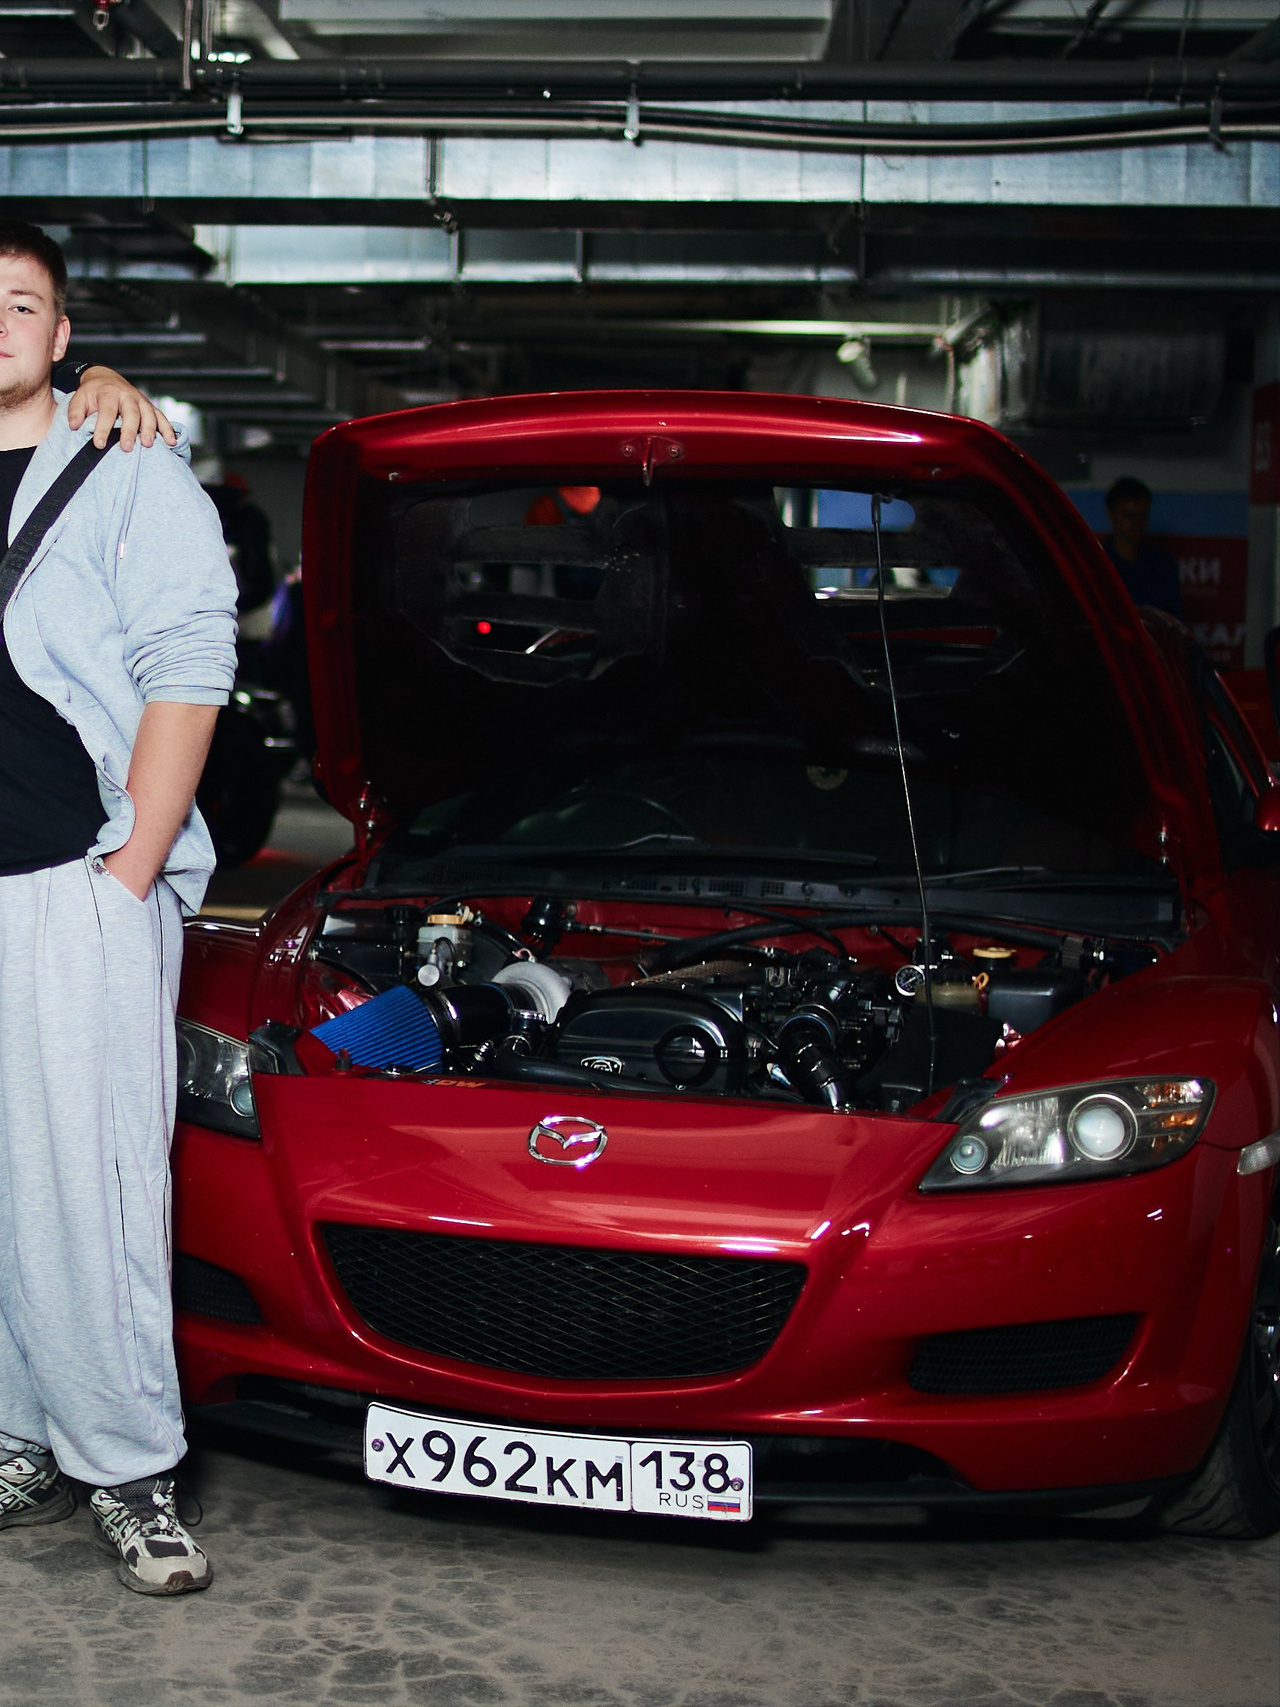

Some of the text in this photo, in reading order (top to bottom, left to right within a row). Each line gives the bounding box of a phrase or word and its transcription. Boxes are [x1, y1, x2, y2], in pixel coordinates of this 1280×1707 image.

[385, 1430, 731, 1502] Х962КМ 138
[658, 1492, 705, 1509] RUS
